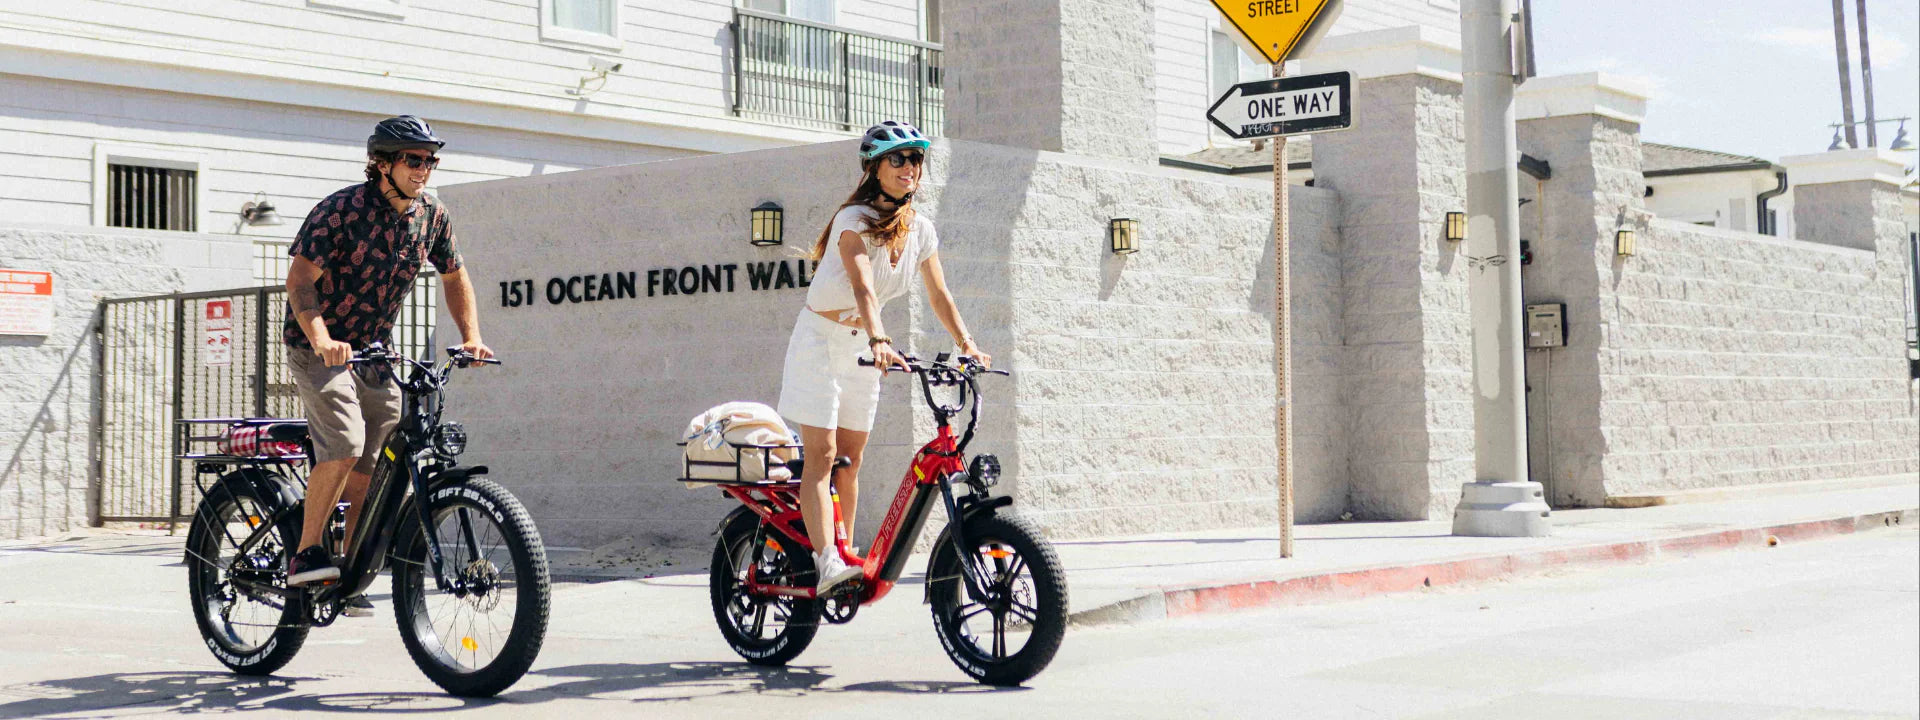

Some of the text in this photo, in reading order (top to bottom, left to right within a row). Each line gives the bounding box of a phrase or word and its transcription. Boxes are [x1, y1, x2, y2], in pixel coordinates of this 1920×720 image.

[1248, 0, 1299, 18] STREET
[1247, 91, 1334, 120] ONE WAY
[500, 259, 817, 307] 151 OCEAN FRONT WAL
